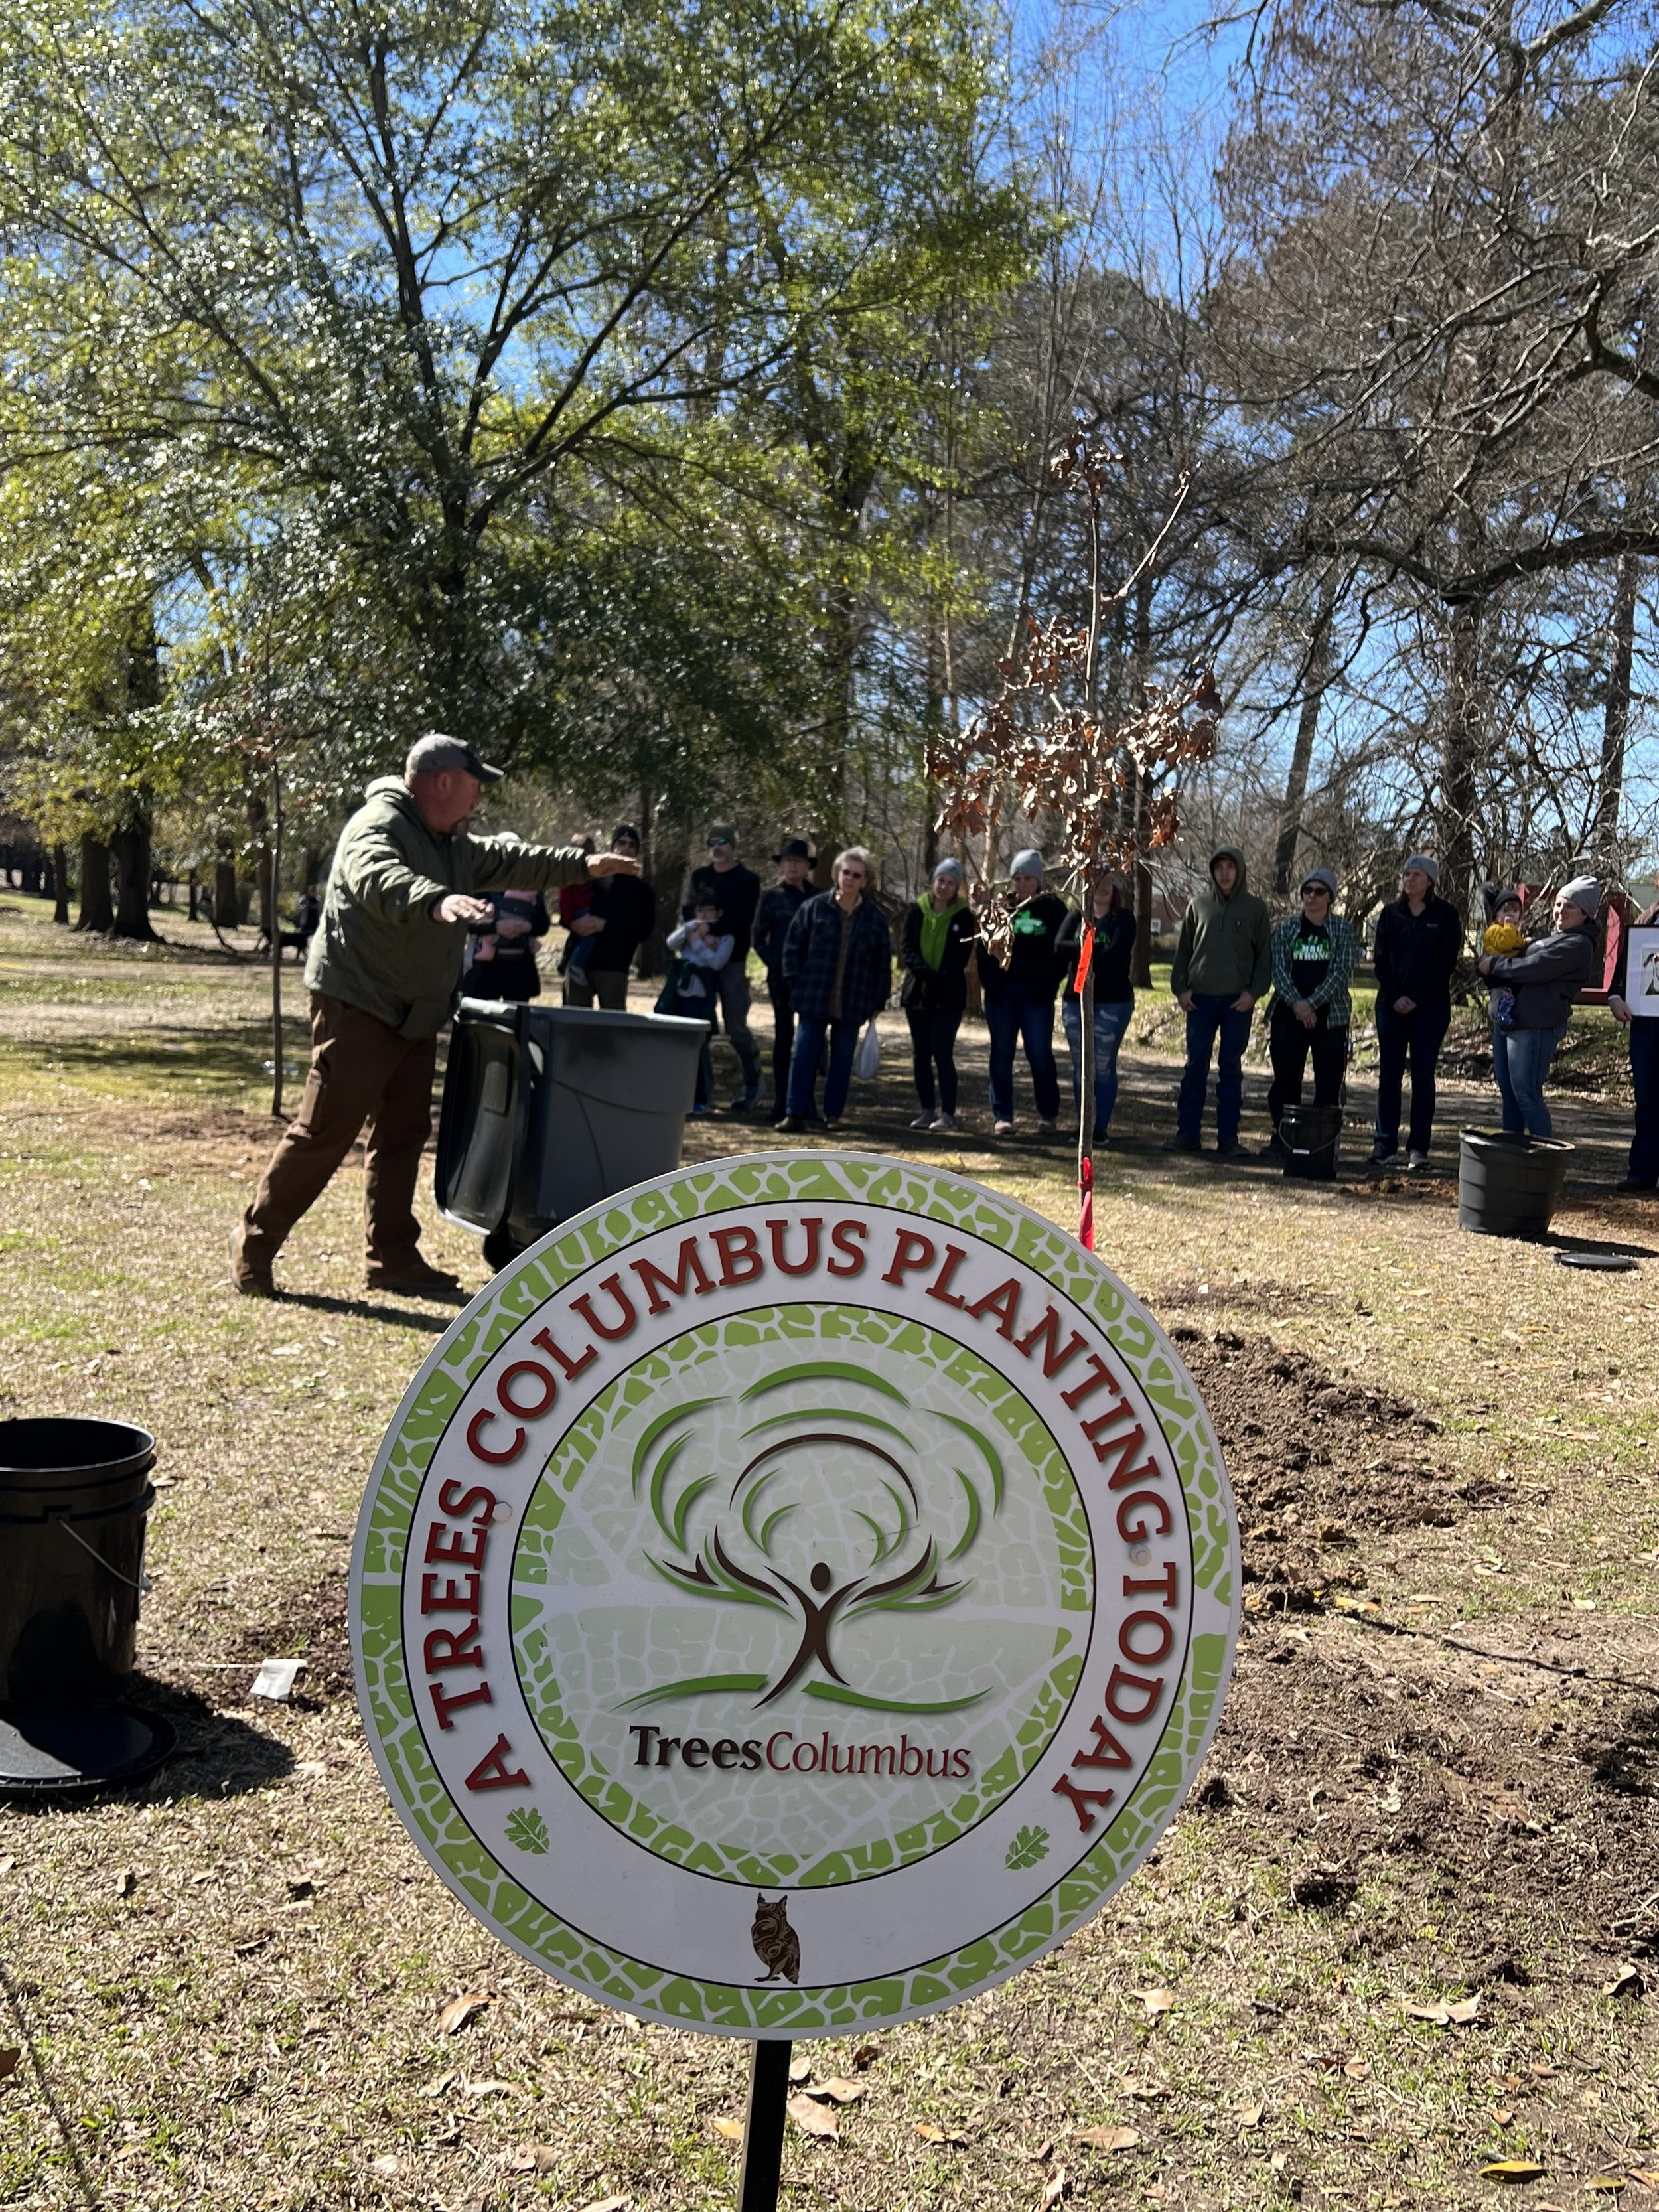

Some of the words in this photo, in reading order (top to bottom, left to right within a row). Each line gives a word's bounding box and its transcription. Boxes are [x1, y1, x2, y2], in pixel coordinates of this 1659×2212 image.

[467, 1219, 867, 1465] COLUMBUS
[881, 1228, 1172, 1542] PLANTING
[421, 1479, 496, 1730] TREES
[1052, 1562, 1177, 1832] TODAY
[466, 1735, 529, 1790] A
